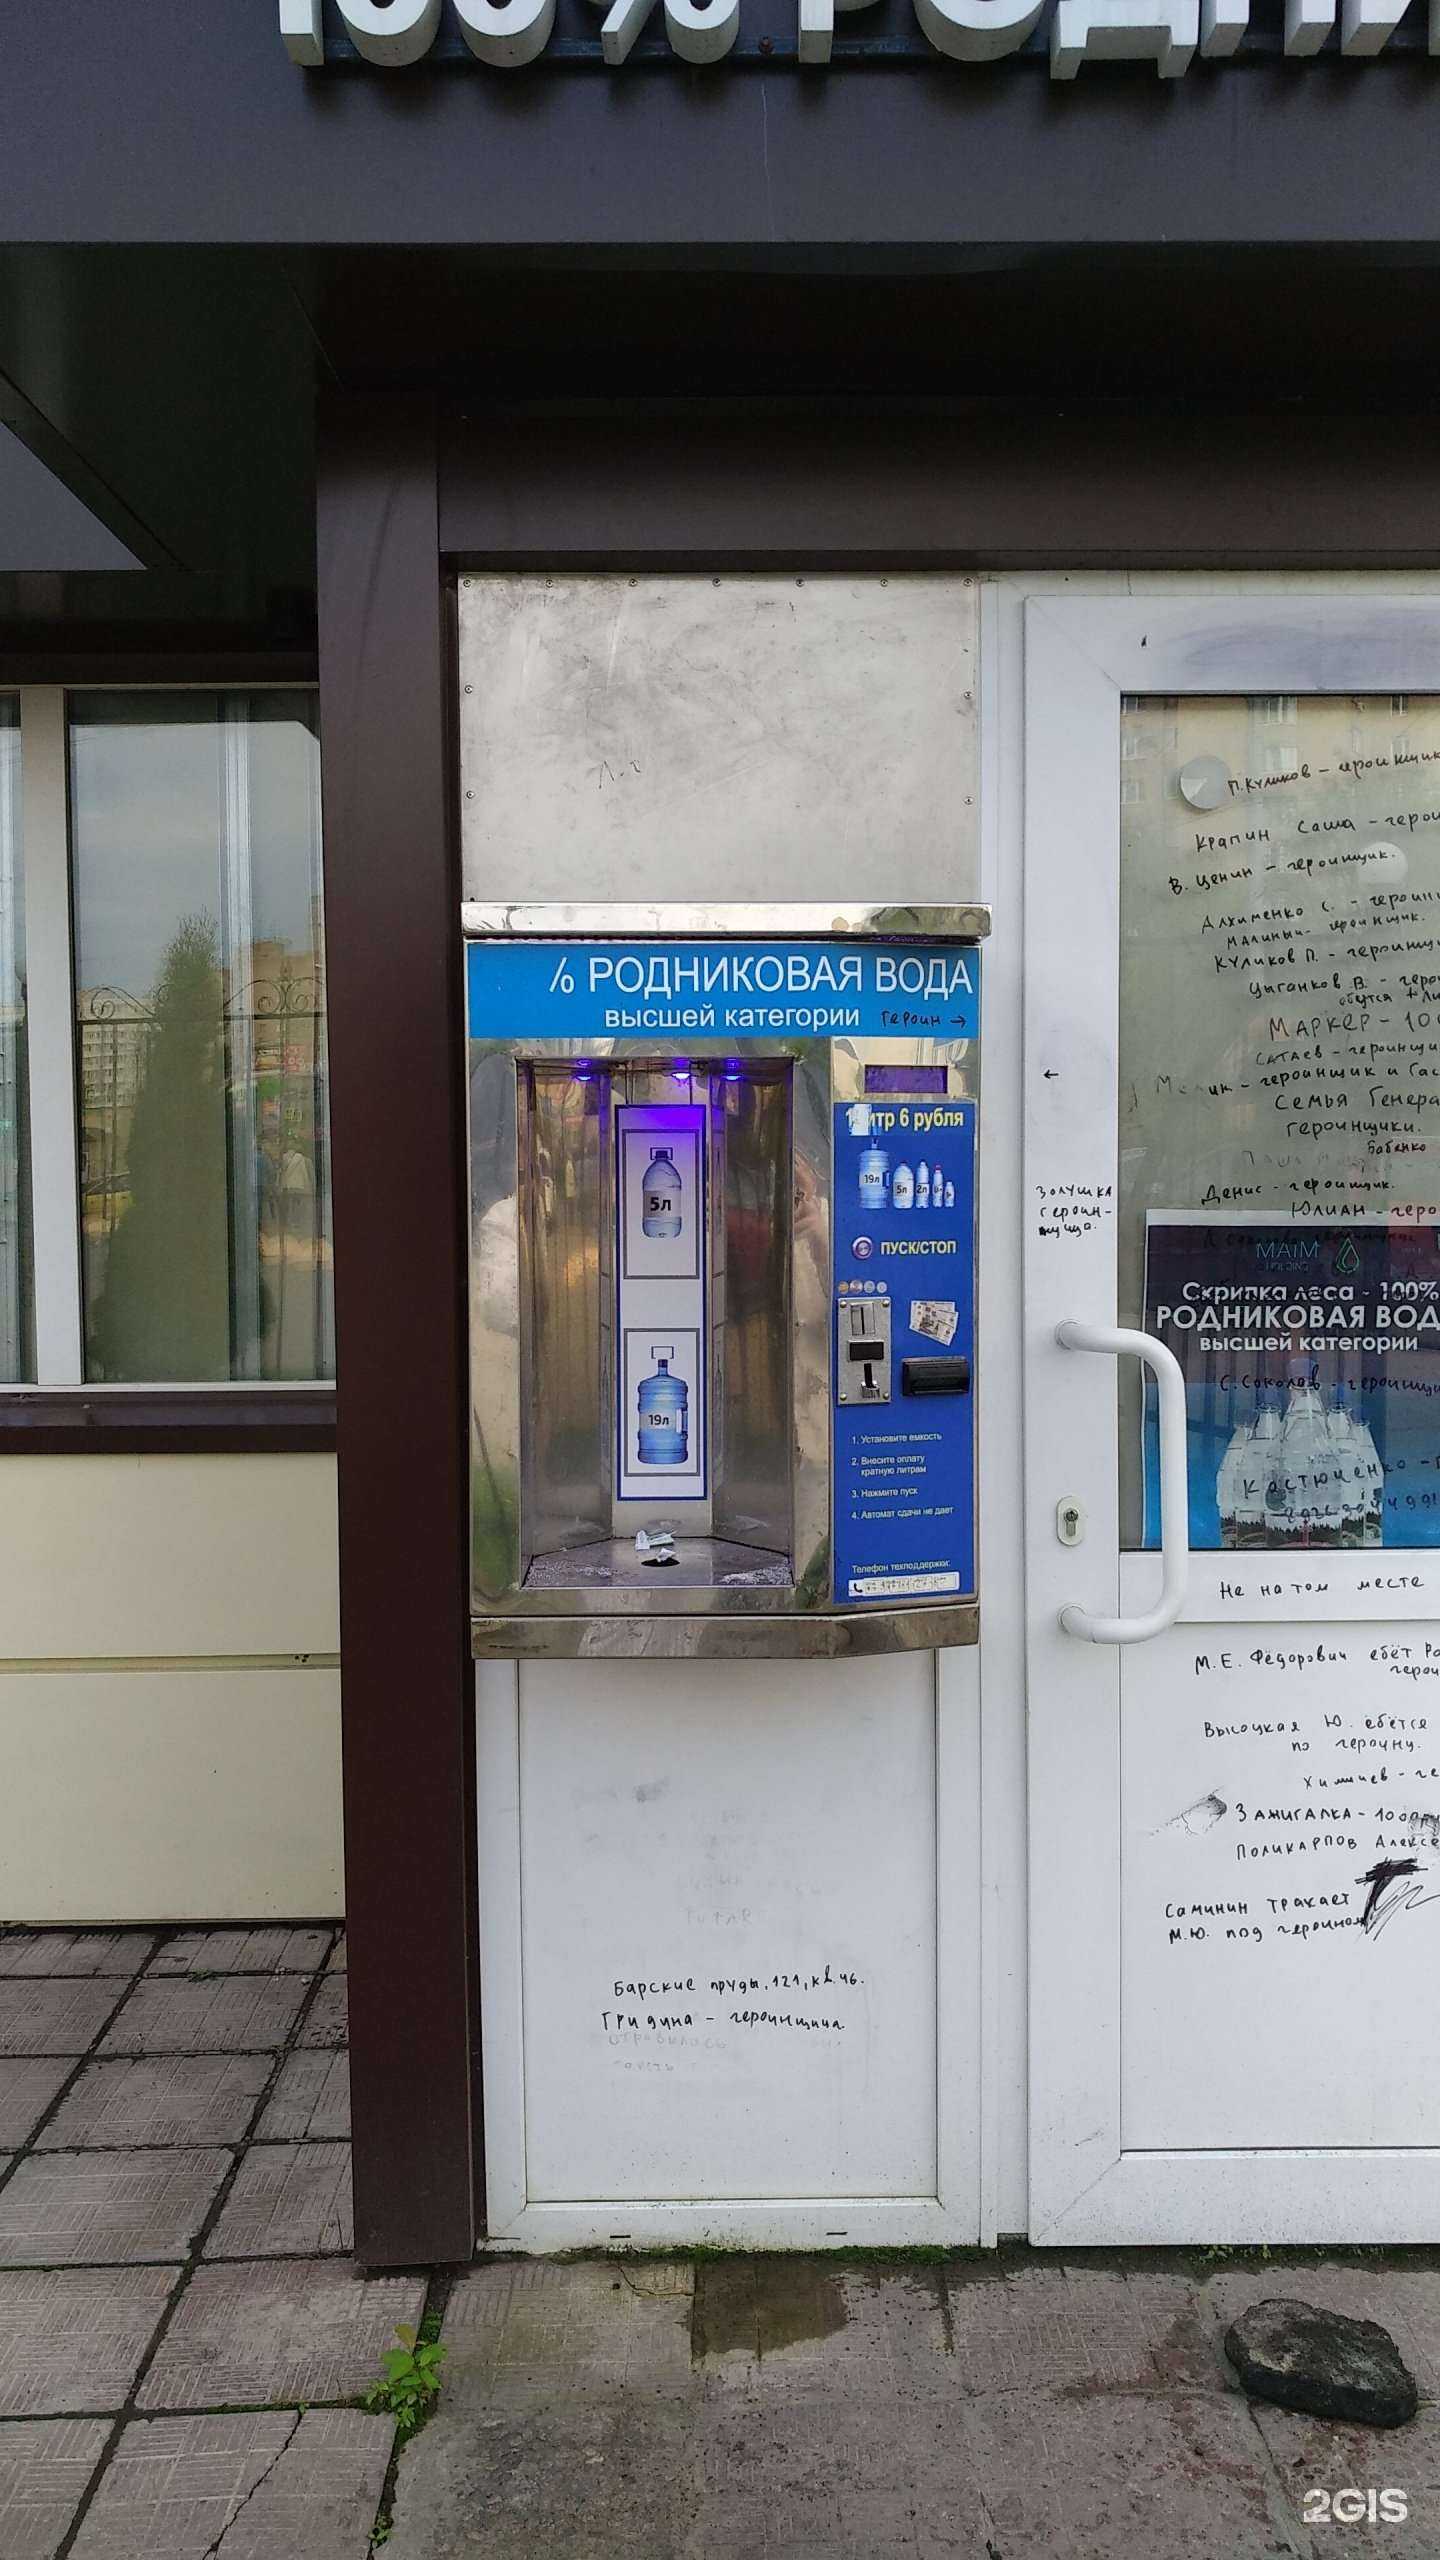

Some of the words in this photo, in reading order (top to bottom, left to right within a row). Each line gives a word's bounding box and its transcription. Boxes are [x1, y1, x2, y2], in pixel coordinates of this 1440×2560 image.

[1298, 818, 1356, 834] Саша
[1214, 948, 1296, 973] Куликов
[589, 956, 862, 1000] РОДНИКОВАЯ
[875, 957, 974, 1000] ВОДА
[605, 1003, 716, 1028] высшей
[725, 1008, 860, 1031] категории
[1275, 1093, 1348, 1110] Семья
[860, 1111, 896, 1132] итр
[900, 1107, 910, 1128] 6
[914, 1107, 965, 1132] рубля
[1201, 1184, 1263, 1206] Денис
[650, 1196, 672, 1213] 5л
[880, 1240, 956, 1256] ПУСК/СТОП
[1182, 1281, 1287, 1305] Скрипка
[1293, 1285, 1354, 1301] леса
[1380, 1281, 1439, 1302] 100%
[1156, 1304, 1365, 1331] РОДНИКОВАЯ
[1200, 1332, 1292, 1352] высшей
[1300, 1336, 1418, 1355] категории
[648, 1413, 670, 1426] 19л
[861, 1434, 908, 1445] Установите
[909, 1433, 943, 1442] емкость
[861, 1456, 895, 1466] Внесите
[897, 1455, 925, 1465] оплату
[861, 1467, 897, 1477] кратную
[897, 1466, 927, 1475] литрам
[861, 1488, 898, 1498] Нажмите
[899, 1487, 918, 1498] пуск
[861, 1510, 895, 1520] Автомат
[897, 1509, 922, 1519] сдачи
[923, 1508, 933, 1516] не
[934, 1506, 953, 1516] дает
[852, 1563, 888, 1574] Телефон
[1220, 1581, 1245, 1599] Не
[1357, 1576, 1425, 1590] месте
[613, 1977, 697, 2000] Барские
